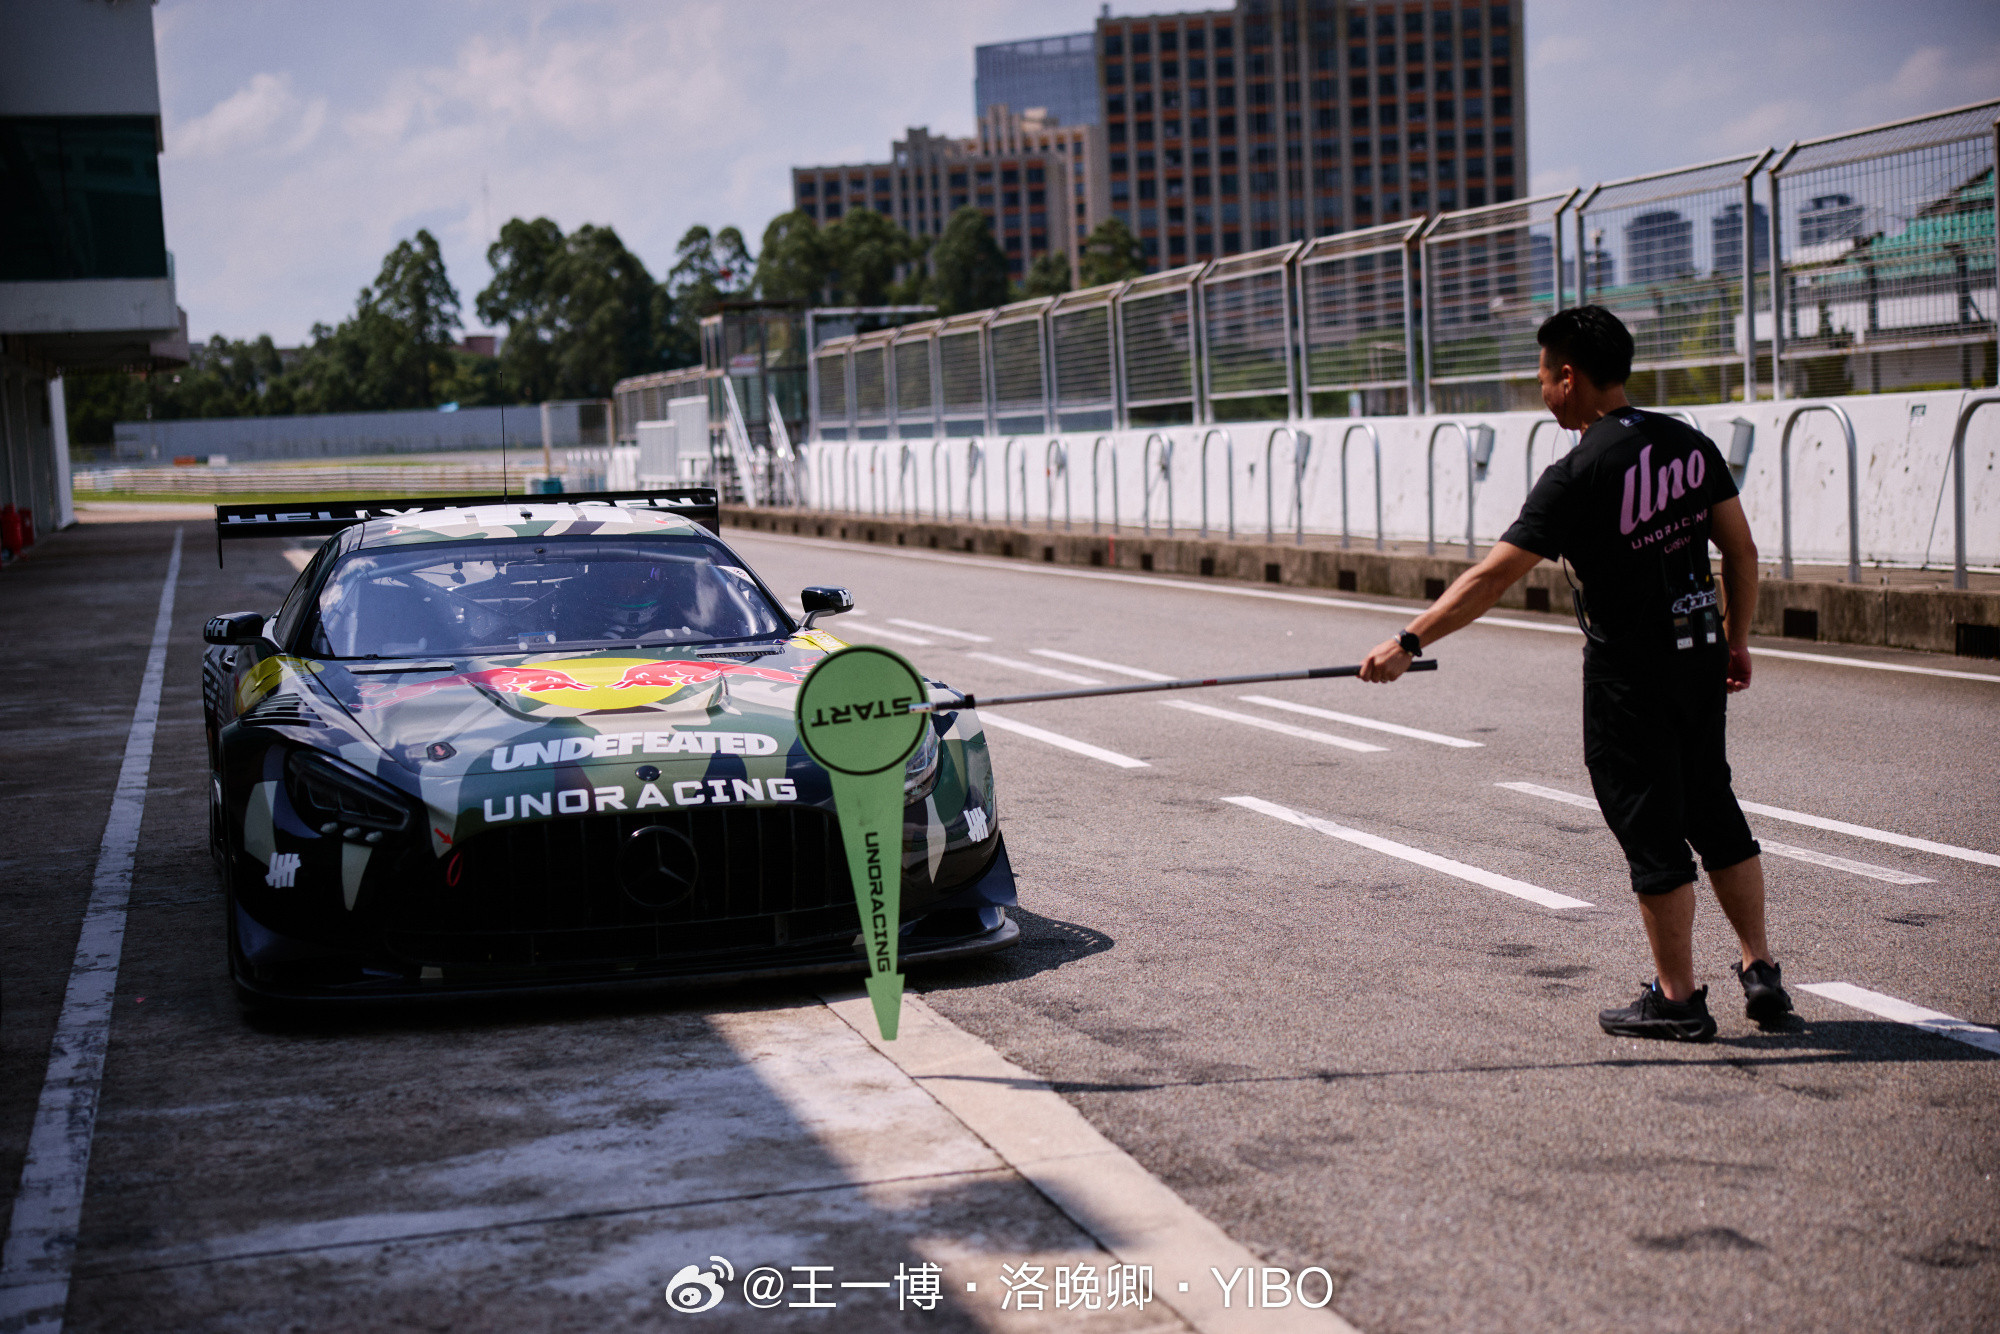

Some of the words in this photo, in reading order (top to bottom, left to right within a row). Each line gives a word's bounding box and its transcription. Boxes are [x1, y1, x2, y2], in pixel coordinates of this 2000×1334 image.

[1620, 443, 1705, 535] Uno
[811, 697, 912, 727] START
[491, 731, 779, 771] UNDEFEATED
[483, 778, 798, 823] UNORACING
[865, 831, 891, 973] UNORACING
